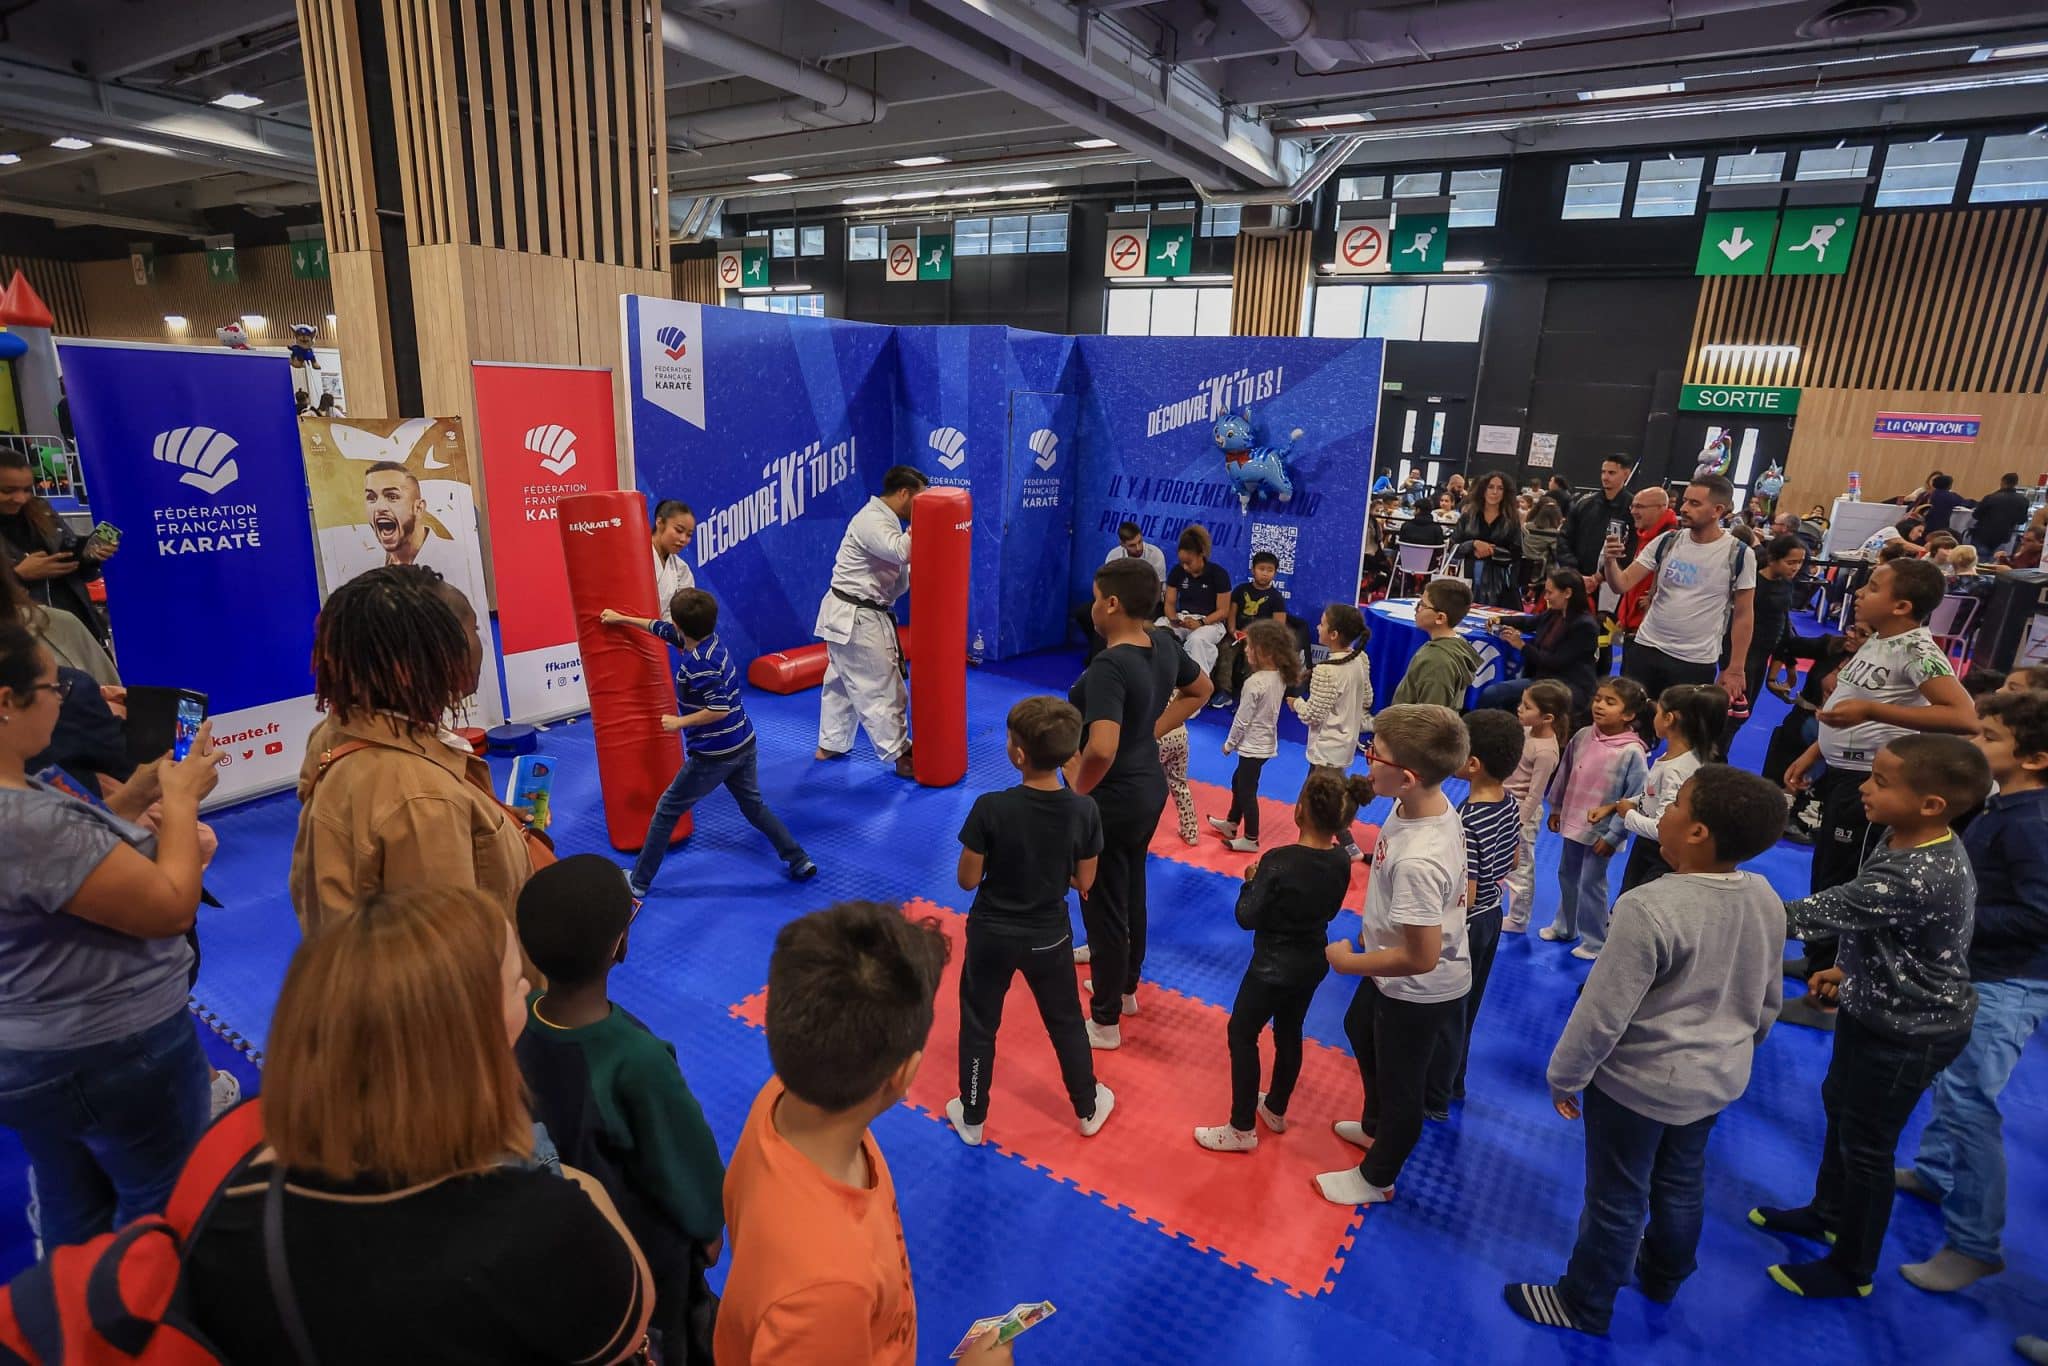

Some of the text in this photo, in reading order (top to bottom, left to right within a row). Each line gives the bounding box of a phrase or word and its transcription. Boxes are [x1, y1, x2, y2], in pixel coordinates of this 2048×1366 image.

[654, 365, 692, 373] FÉDÉRATION
[655, 373, 692, 381] FRANÇAISE
[656, 381, 692, 390] KARATÉ
[1147, 392, 1210, 438] DÉCOUVRE
[1237, 376, 1254, 407] TU
[1256, 370, 1274, 401] ES
[1697, 390, 1781, 409] SORTIE
[1887, 421, 1901, 431] LA
[1024, 477, 1061, 486] FÉDÉRATION
[1109, 474, 1122, 498] IL
[1127, 476, 1139, 499] Y
[1140, 477, 1151, 502] A
[523, 483, 587, 495] FÉDÉRATION
[1023, 486, 1059, 496] FRANÇAISE
[696, 480, 778, 568] DÉCOUVRE
[809, 451, 828, 498] TU
[831, 441, 847, 487] ES
[1022, 494, 1059, 508] KARATÉ
[154, 503, 257, 520] FÉDÉRATION
[526, 507, 558, 521] KAR
[156, 517, 259, 536] FRANÇAISE
[1142, 514, 1160, 538] DE
[158, 529, 261, 556] KARATÉ
[545, 658, 581, 672] ffkarat
[211, 722, 280, 748] karate.fr
